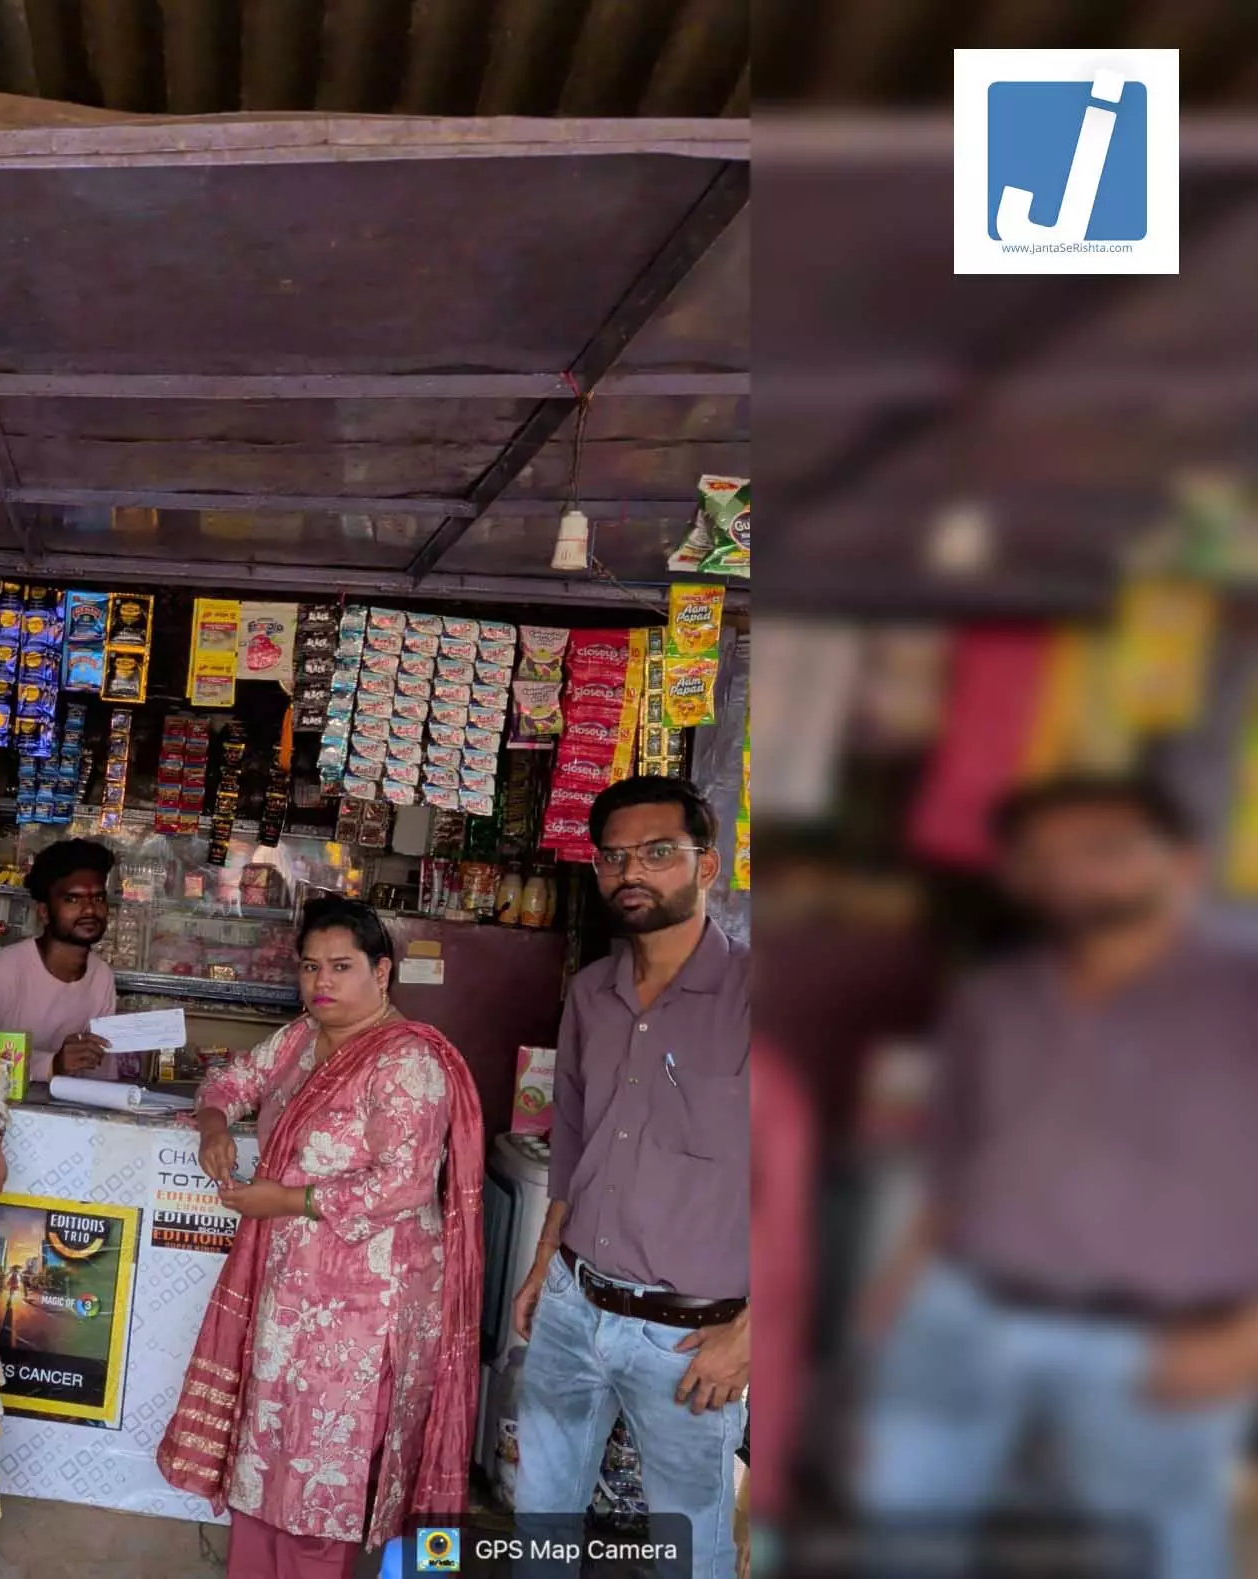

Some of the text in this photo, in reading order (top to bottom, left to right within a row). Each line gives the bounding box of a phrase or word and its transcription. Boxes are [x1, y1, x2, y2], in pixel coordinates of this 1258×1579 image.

[577, 646, 619, 659] closeup
[158, 1172, 220, 1189] TOTA
[50, 1213, 105, 1233] EDITIONS
[154, 1211, 235, 1229] EDITIONS
[63, 1230, 90, 1243] TRIO
[153, 1228, 234, 1247] EDITIONS
[41, 1295, 92, 1310] MAGIC OF 3
[19, 1366, 83, 1388] CANCER
